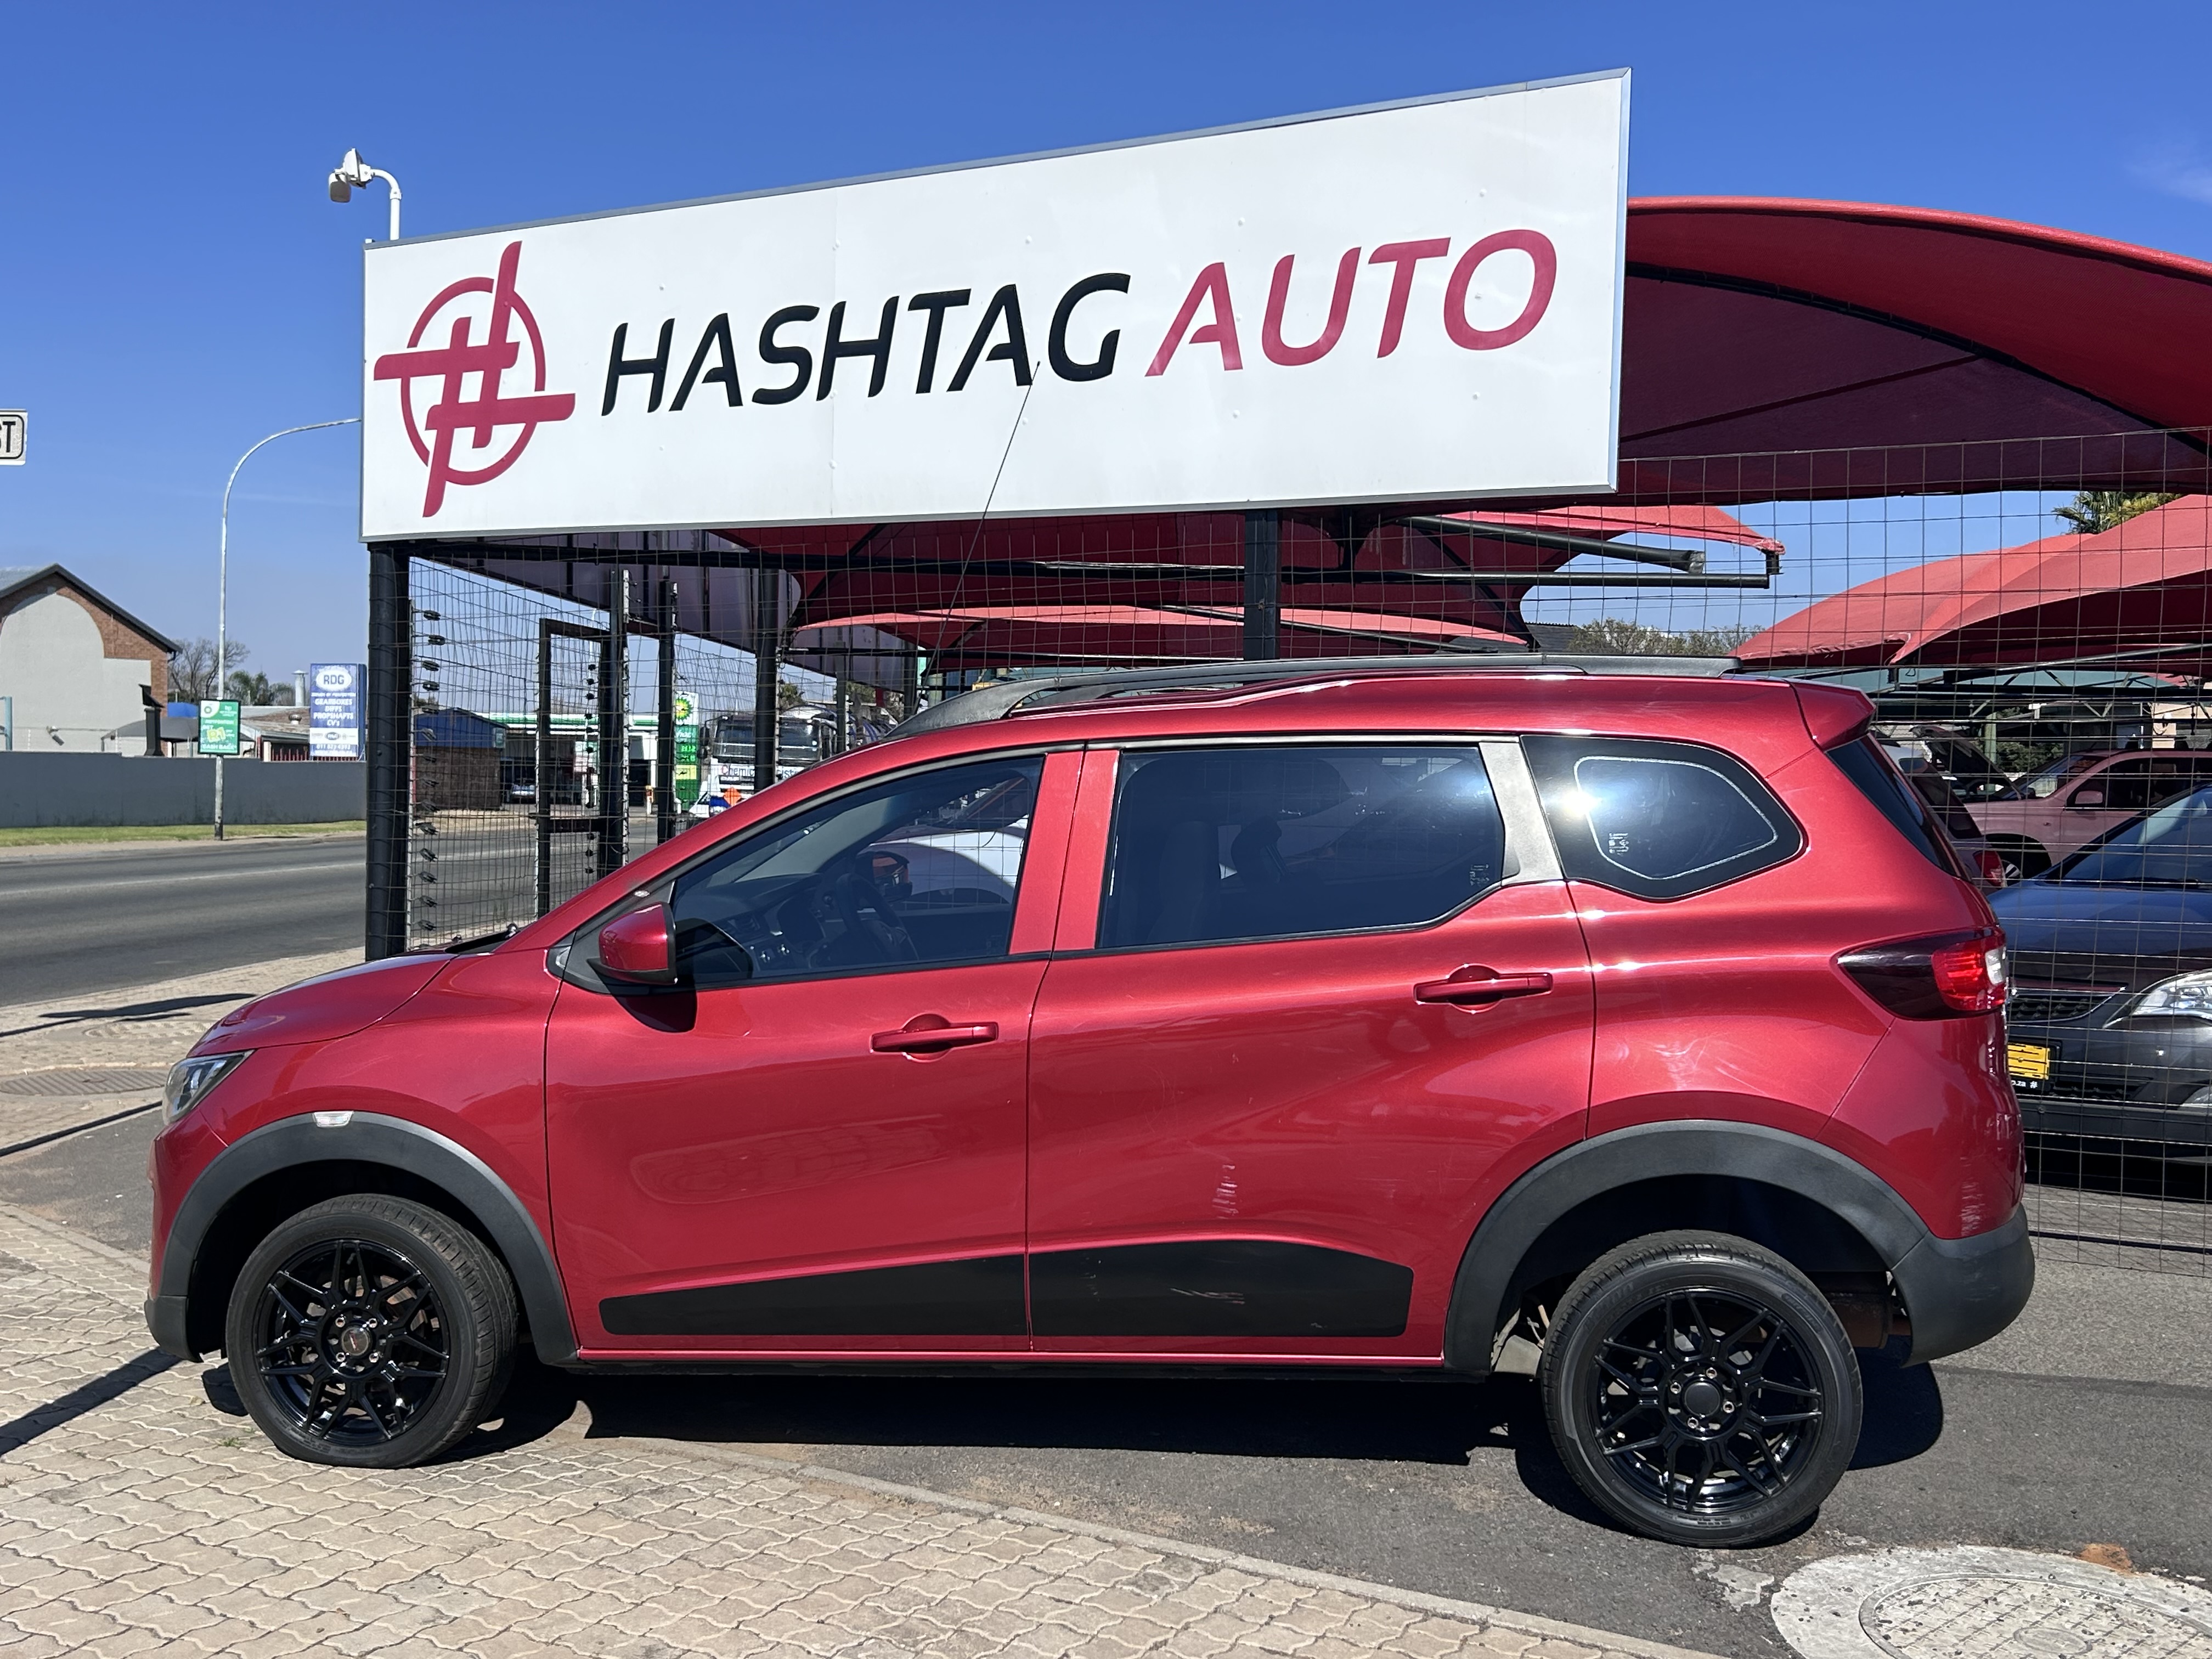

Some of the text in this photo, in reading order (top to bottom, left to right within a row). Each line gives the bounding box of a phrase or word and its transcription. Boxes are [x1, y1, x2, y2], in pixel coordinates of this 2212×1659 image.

[601, 229, 1557, 416] HASHTAG AUTO
[323, 674, 345, 685] RDG
